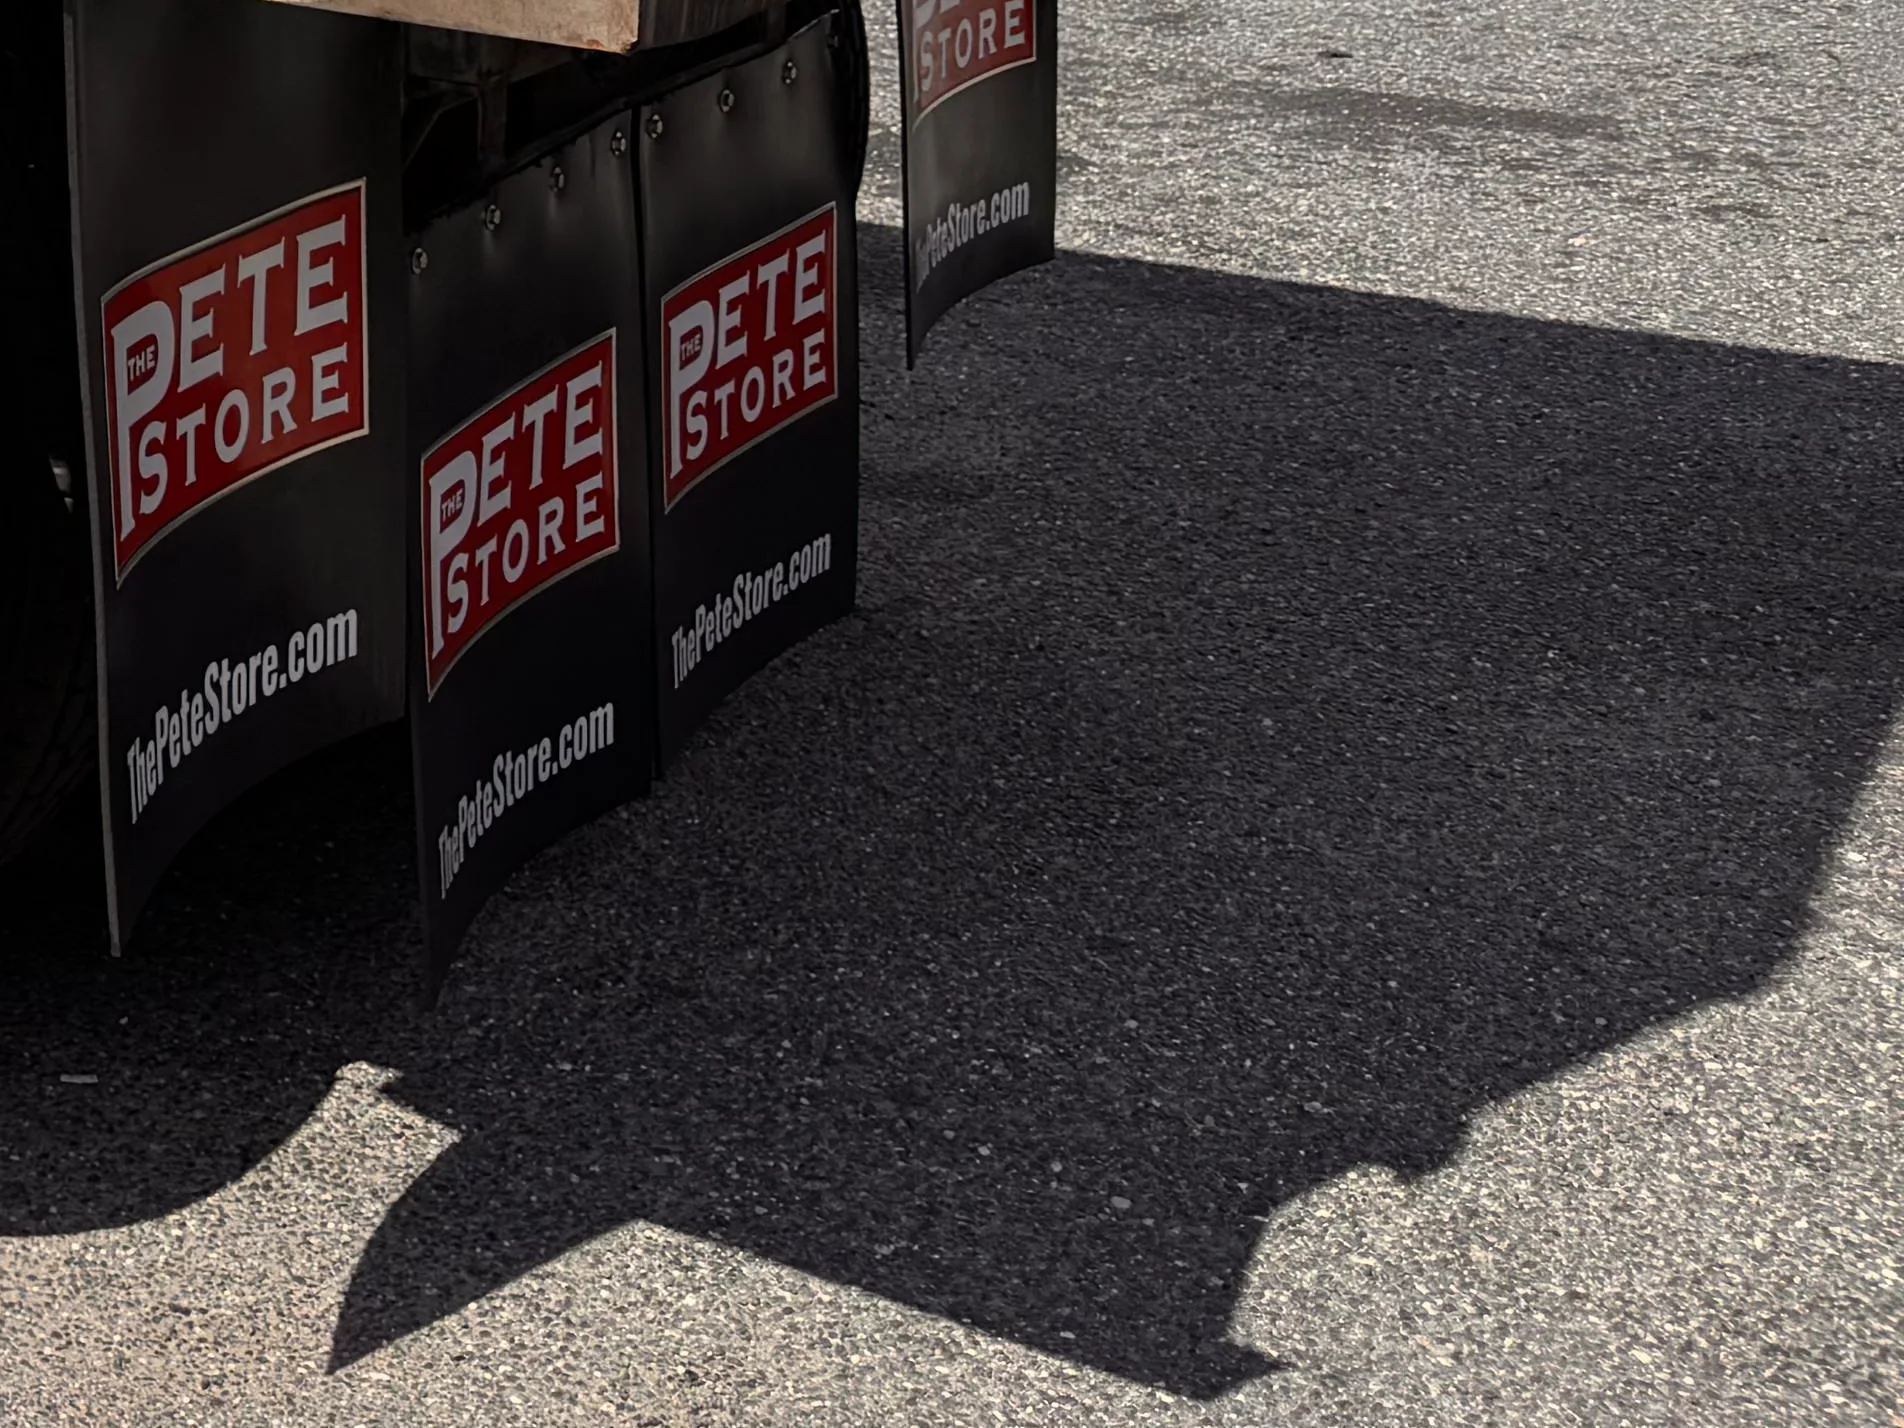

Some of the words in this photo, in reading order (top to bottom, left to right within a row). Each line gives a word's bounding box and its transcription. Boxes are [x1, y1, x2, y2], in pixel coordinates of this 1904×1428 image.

[110, 213, 348, 542] PETE
[127, 345, 157, 382] THE
[138, 342, 350, 516] STORE
[668, 229, 827, 480] PETE
[685, 327, 828, 461] STORE
[428, 359, 604, 660] PETE
[441, 489, 464, 522] THE
[446, 470, 606, 634] STORE
[671, 532, 832, 691] ThePeteStore.com
[126, 608, 359, 825] ThePeteStore.com
[438, 701, 615, 900] ThePeteStore.com
